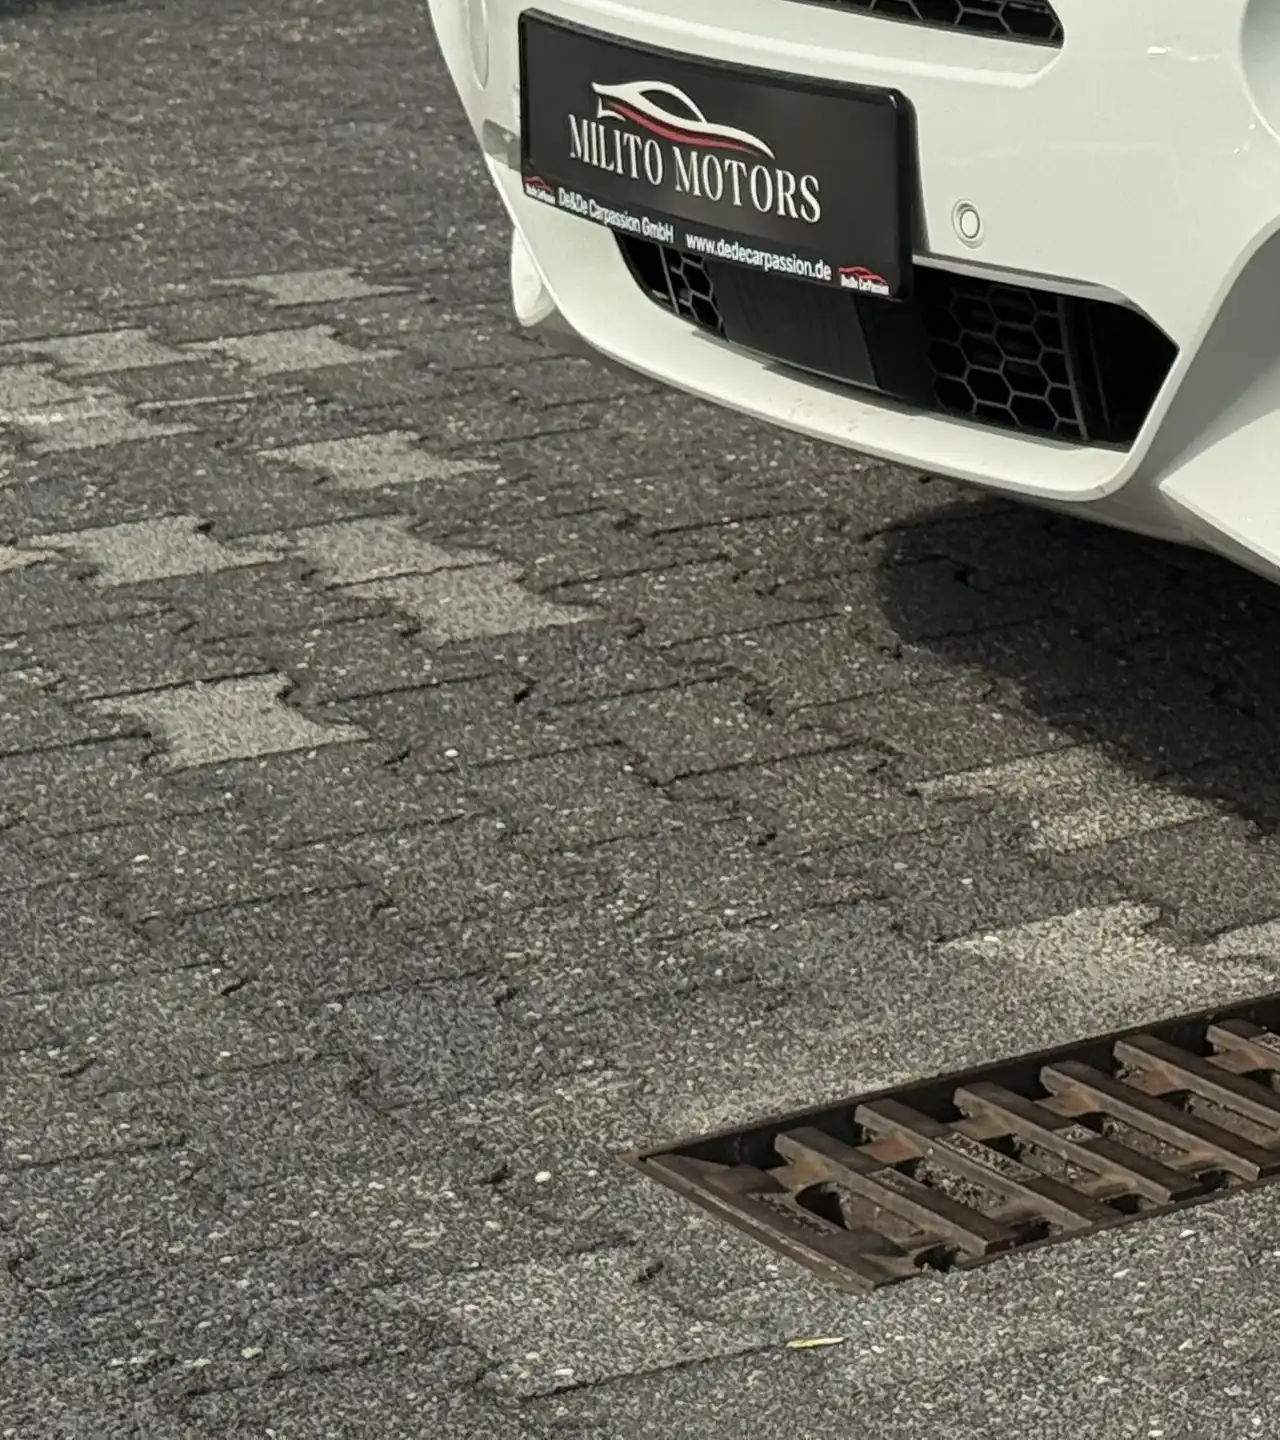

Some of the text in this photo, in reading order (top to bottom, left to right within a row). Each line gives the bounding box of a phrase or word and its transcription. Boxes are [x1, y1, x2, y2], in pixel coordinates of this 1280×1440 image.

[568, 113, 821, 224] MILITO MOTORS
[558, 187, 588, 215] De&De
[589, 198, 641, 236] Carpassion
[641, 216, 675, 244] GmbH
[685, 233, 832, 281] www.dedecarpassion.de
